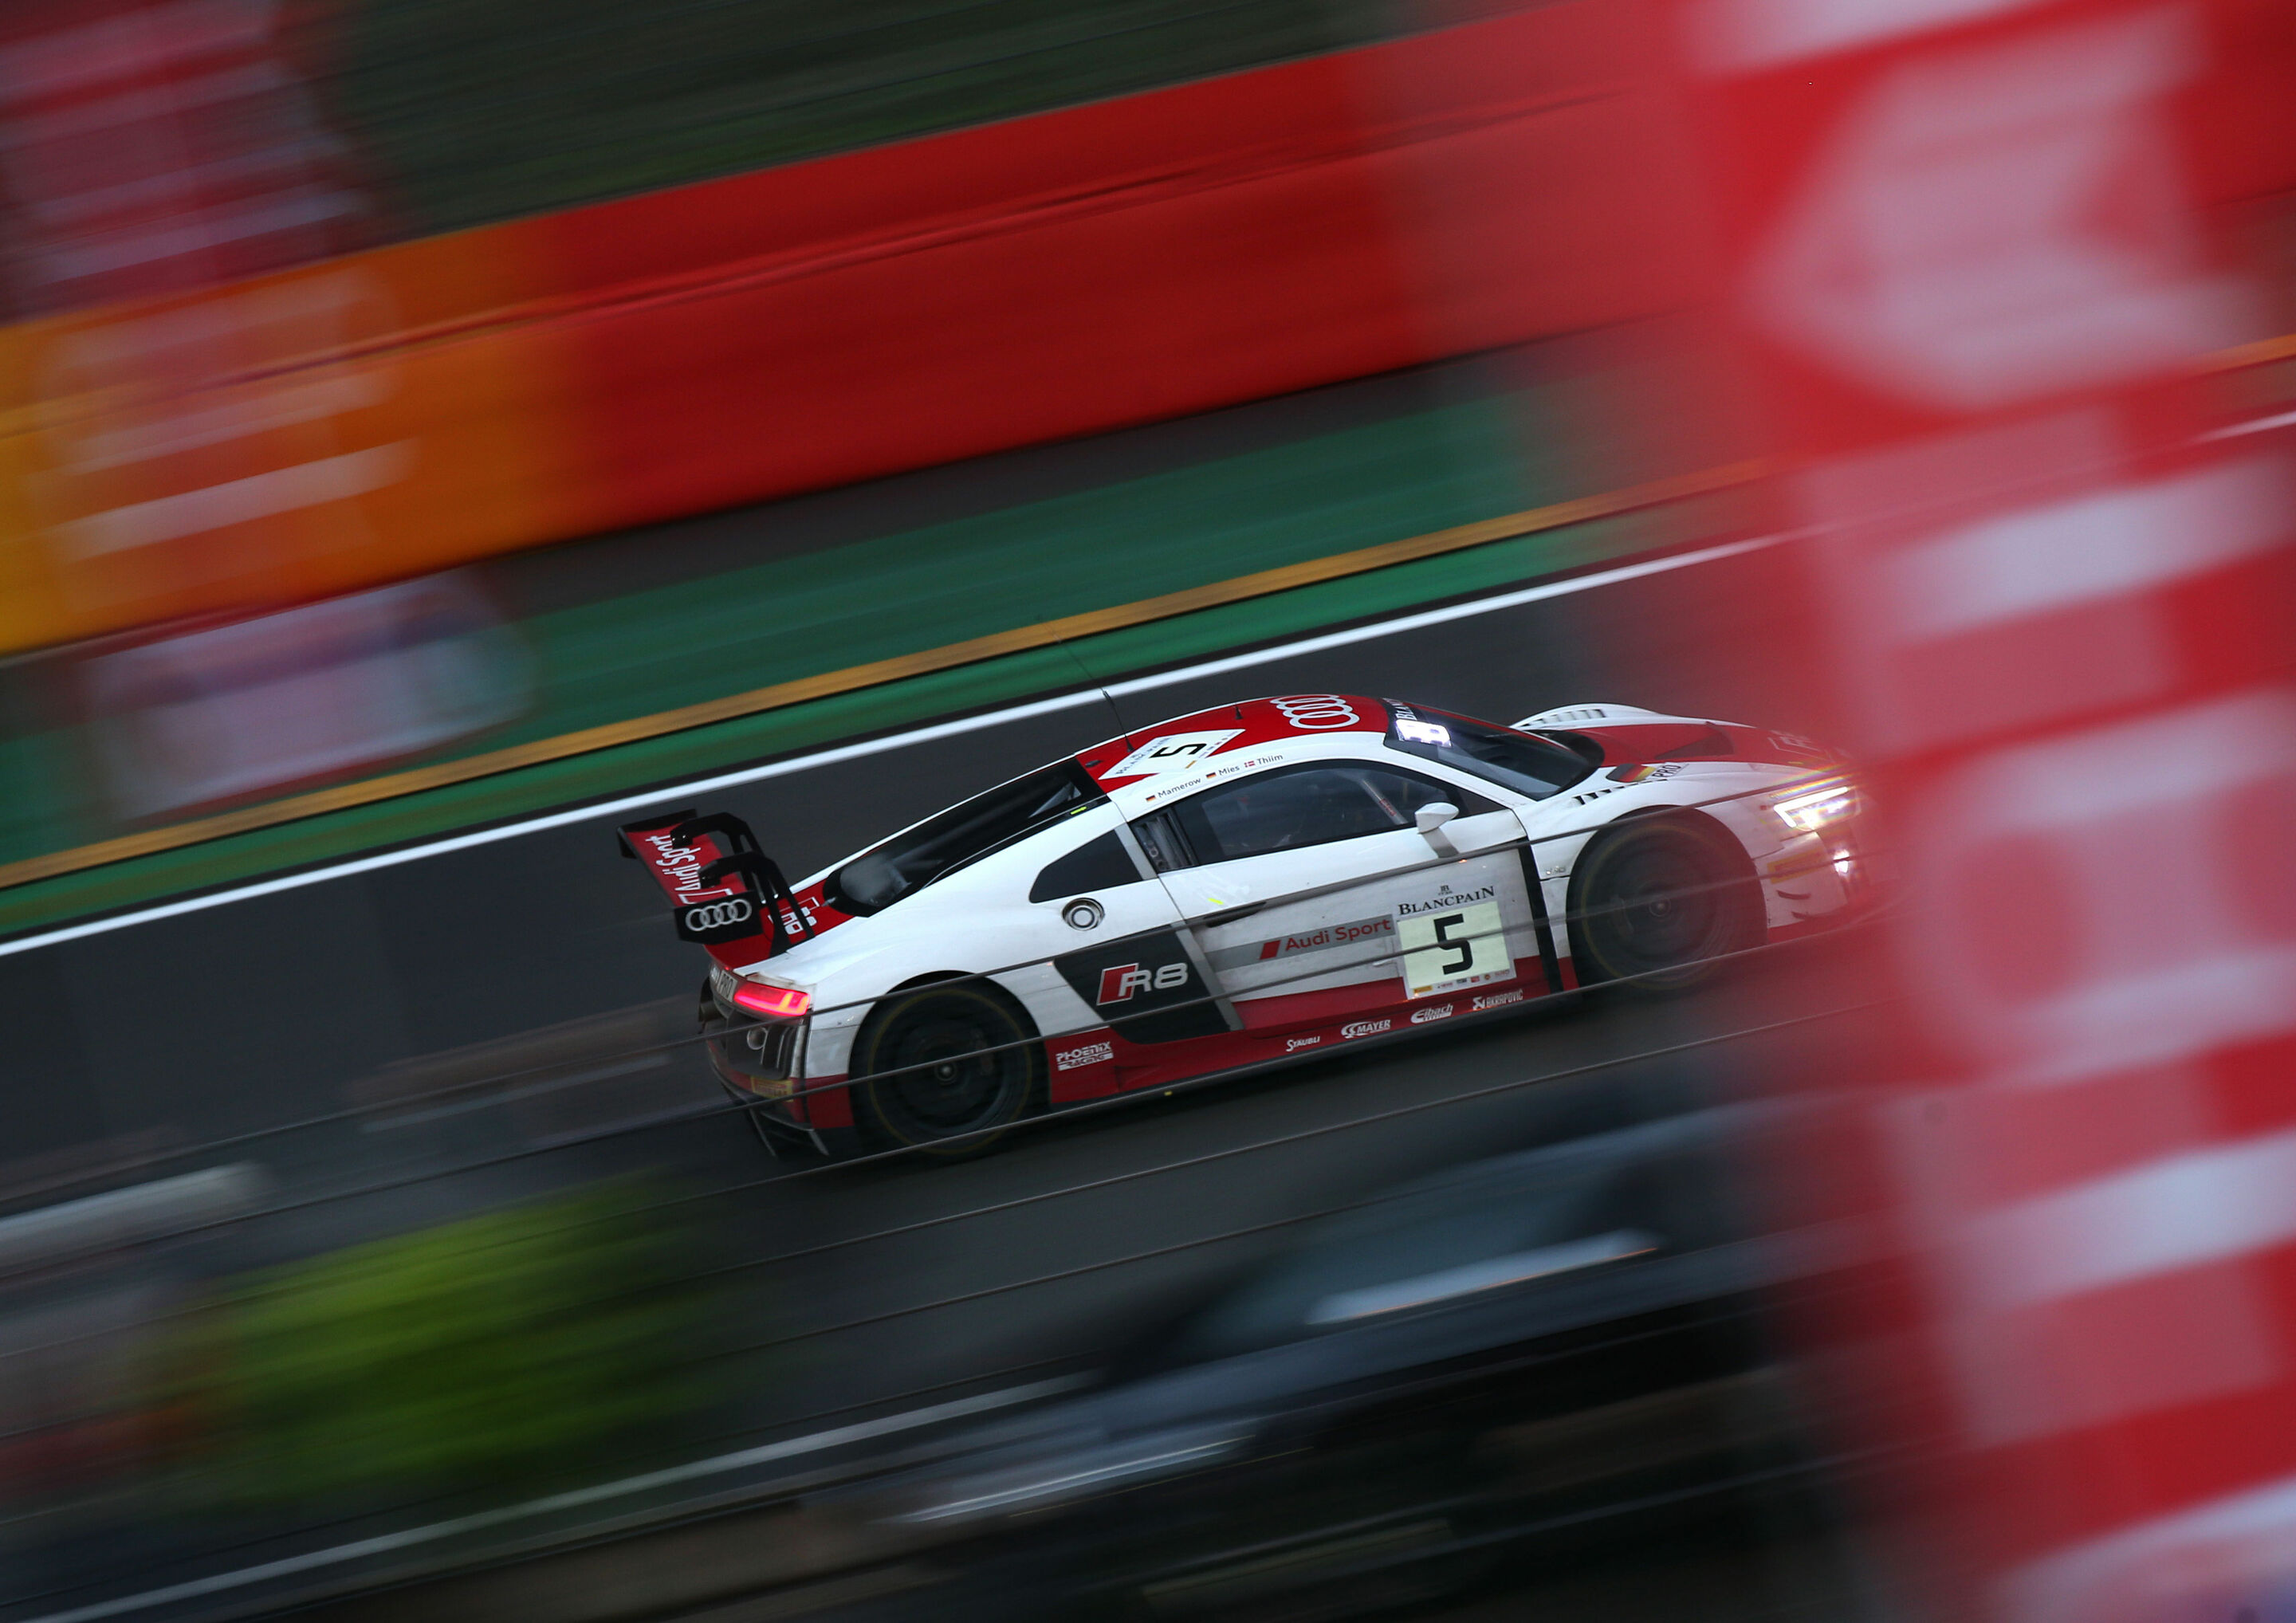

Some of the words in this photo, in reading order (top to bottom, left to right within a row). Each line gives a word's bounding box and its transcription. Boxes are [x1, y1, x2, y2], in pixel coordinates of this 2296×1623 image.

[1148, 743, 1207, 758] 5
[1158, 777, 1201, 798] Mamerow
[1217, 765, 1240, 776] Mies
[1256, 753, 1284, 766] Thiim
[1651, 764, 1681, 778] PRO
[644, 834, 702, 867] Sport
[662, 863, 702, 891] Audi
[1398, 885, 1496, 916] BLANCPAIN
[1285, 930, 1330, 951] Audi
[1335, 919, 1391, 941] Sport
[1433, 914, 1473, 976] 5
[1118, 962, 1189, 997] R8
[1357, 1020, 1391, 1034] MAYER
[1410, 1003, 1453, 1024] Eibach
